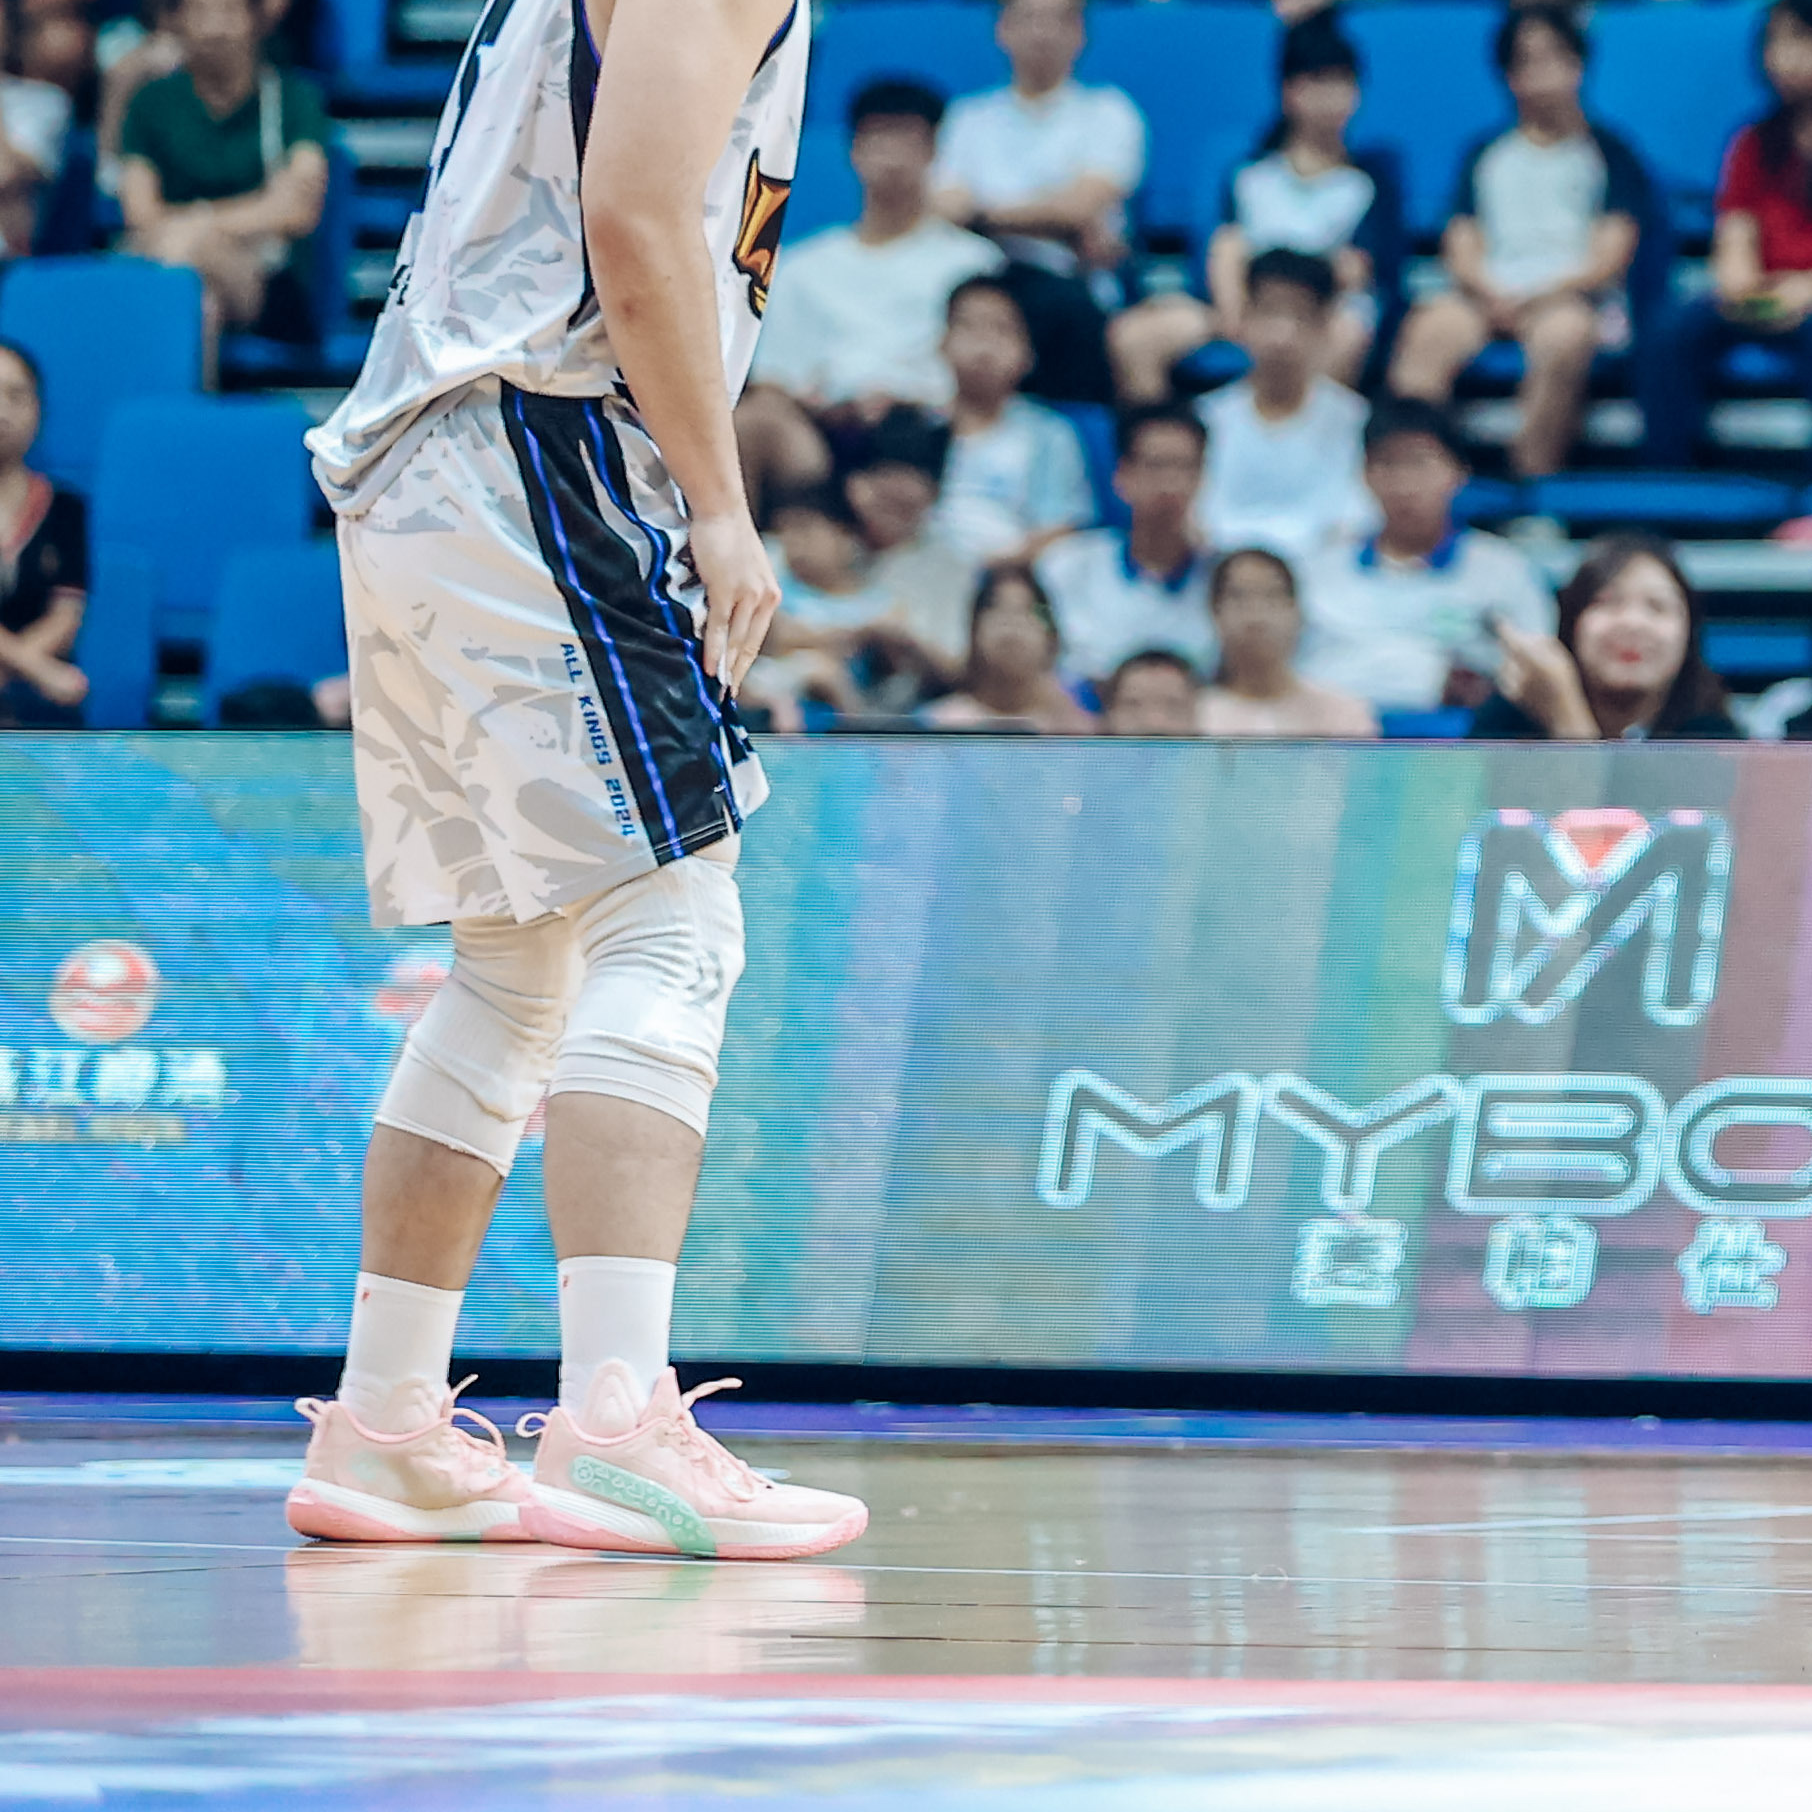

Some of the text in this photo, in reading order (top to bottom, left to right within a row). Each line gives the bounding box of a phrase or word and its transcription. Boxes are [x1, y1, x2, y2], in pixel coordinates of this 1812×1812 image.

[561, 643, 636, 836] ALL KINGS 2024
